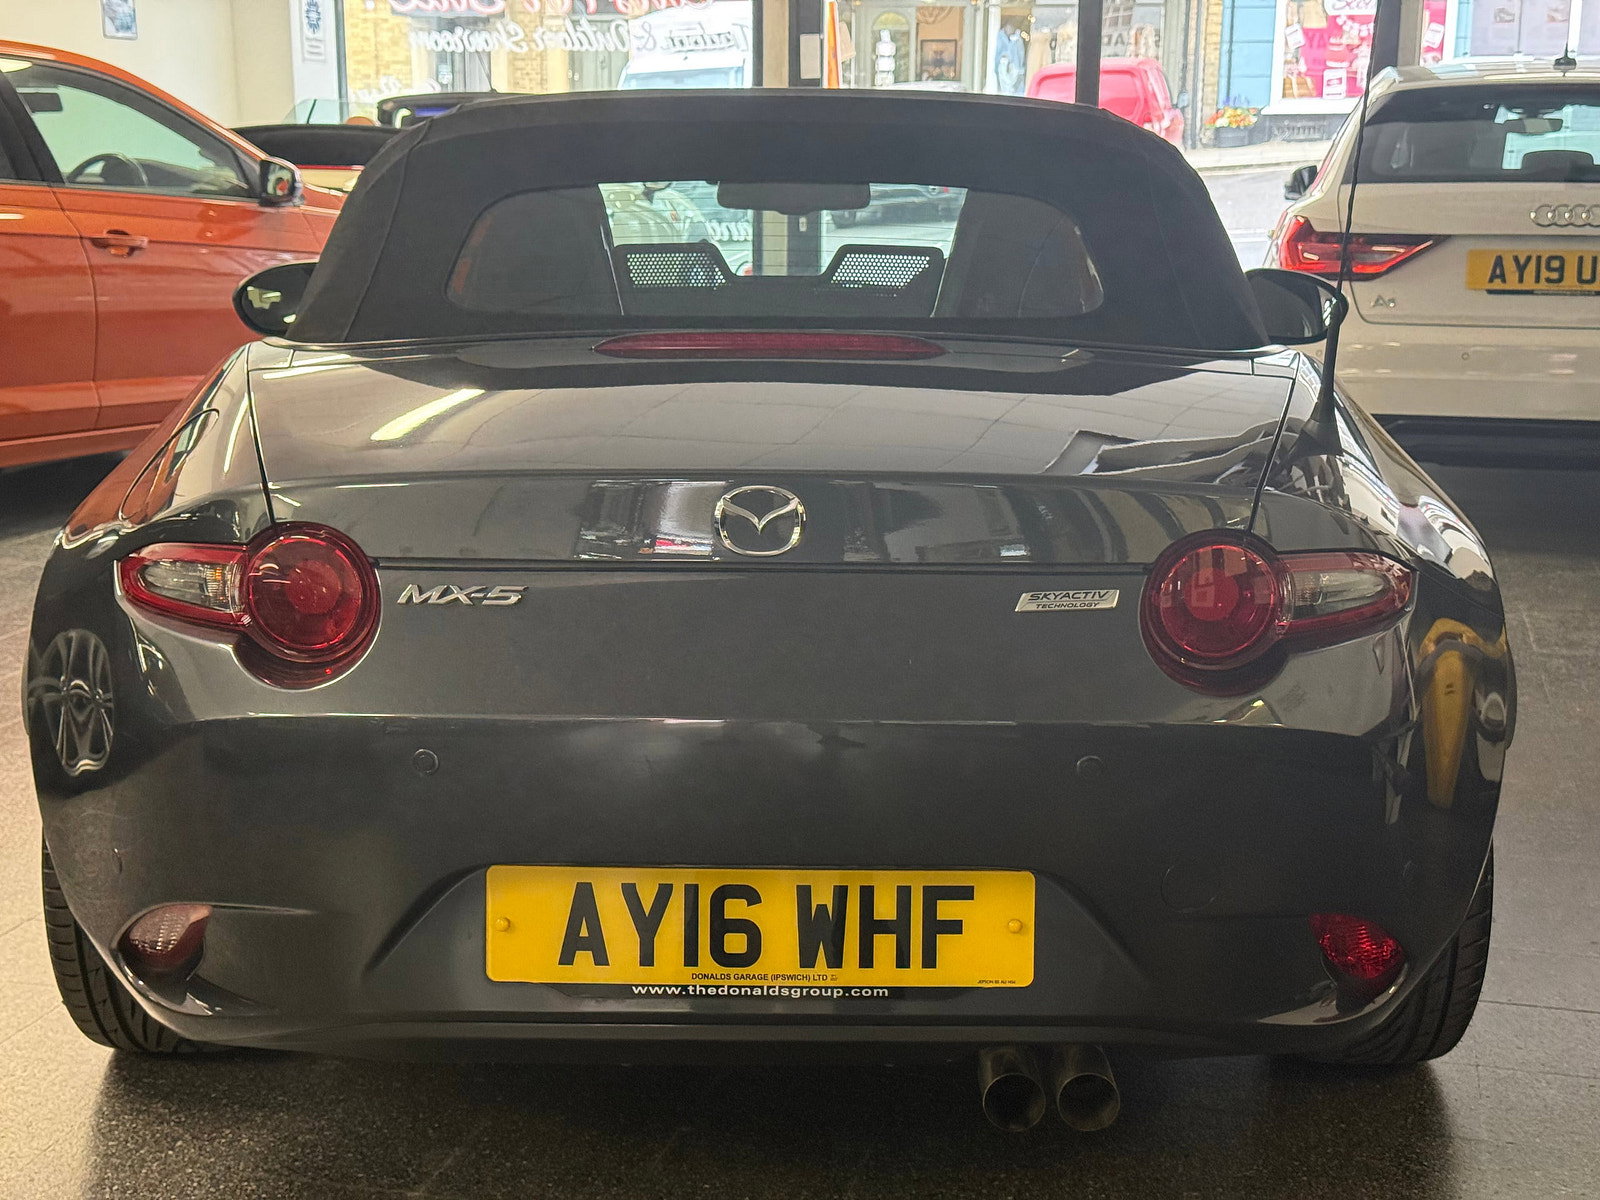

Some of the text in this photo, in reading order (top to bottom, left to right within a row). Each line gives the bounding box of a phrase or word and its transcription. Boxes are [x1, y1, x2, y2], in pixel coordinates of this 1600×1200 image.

[1488, 255, 1599, 284] AY19 U
[397, 584, 529, 605] MX-5
[1028, 591, 1109, 601] SKYACTIV
[557, 881, 976, 970] AY16 WHF
[691, 973, 732, 981] DONALDS
[733, 973, 769, 981] GARAGE
[771, 973, 811, 983] (IPSWICH)
[813, 974, 828, 982] LTD
[631, 984, 890, 999] www.thedonaldsgroup.com
